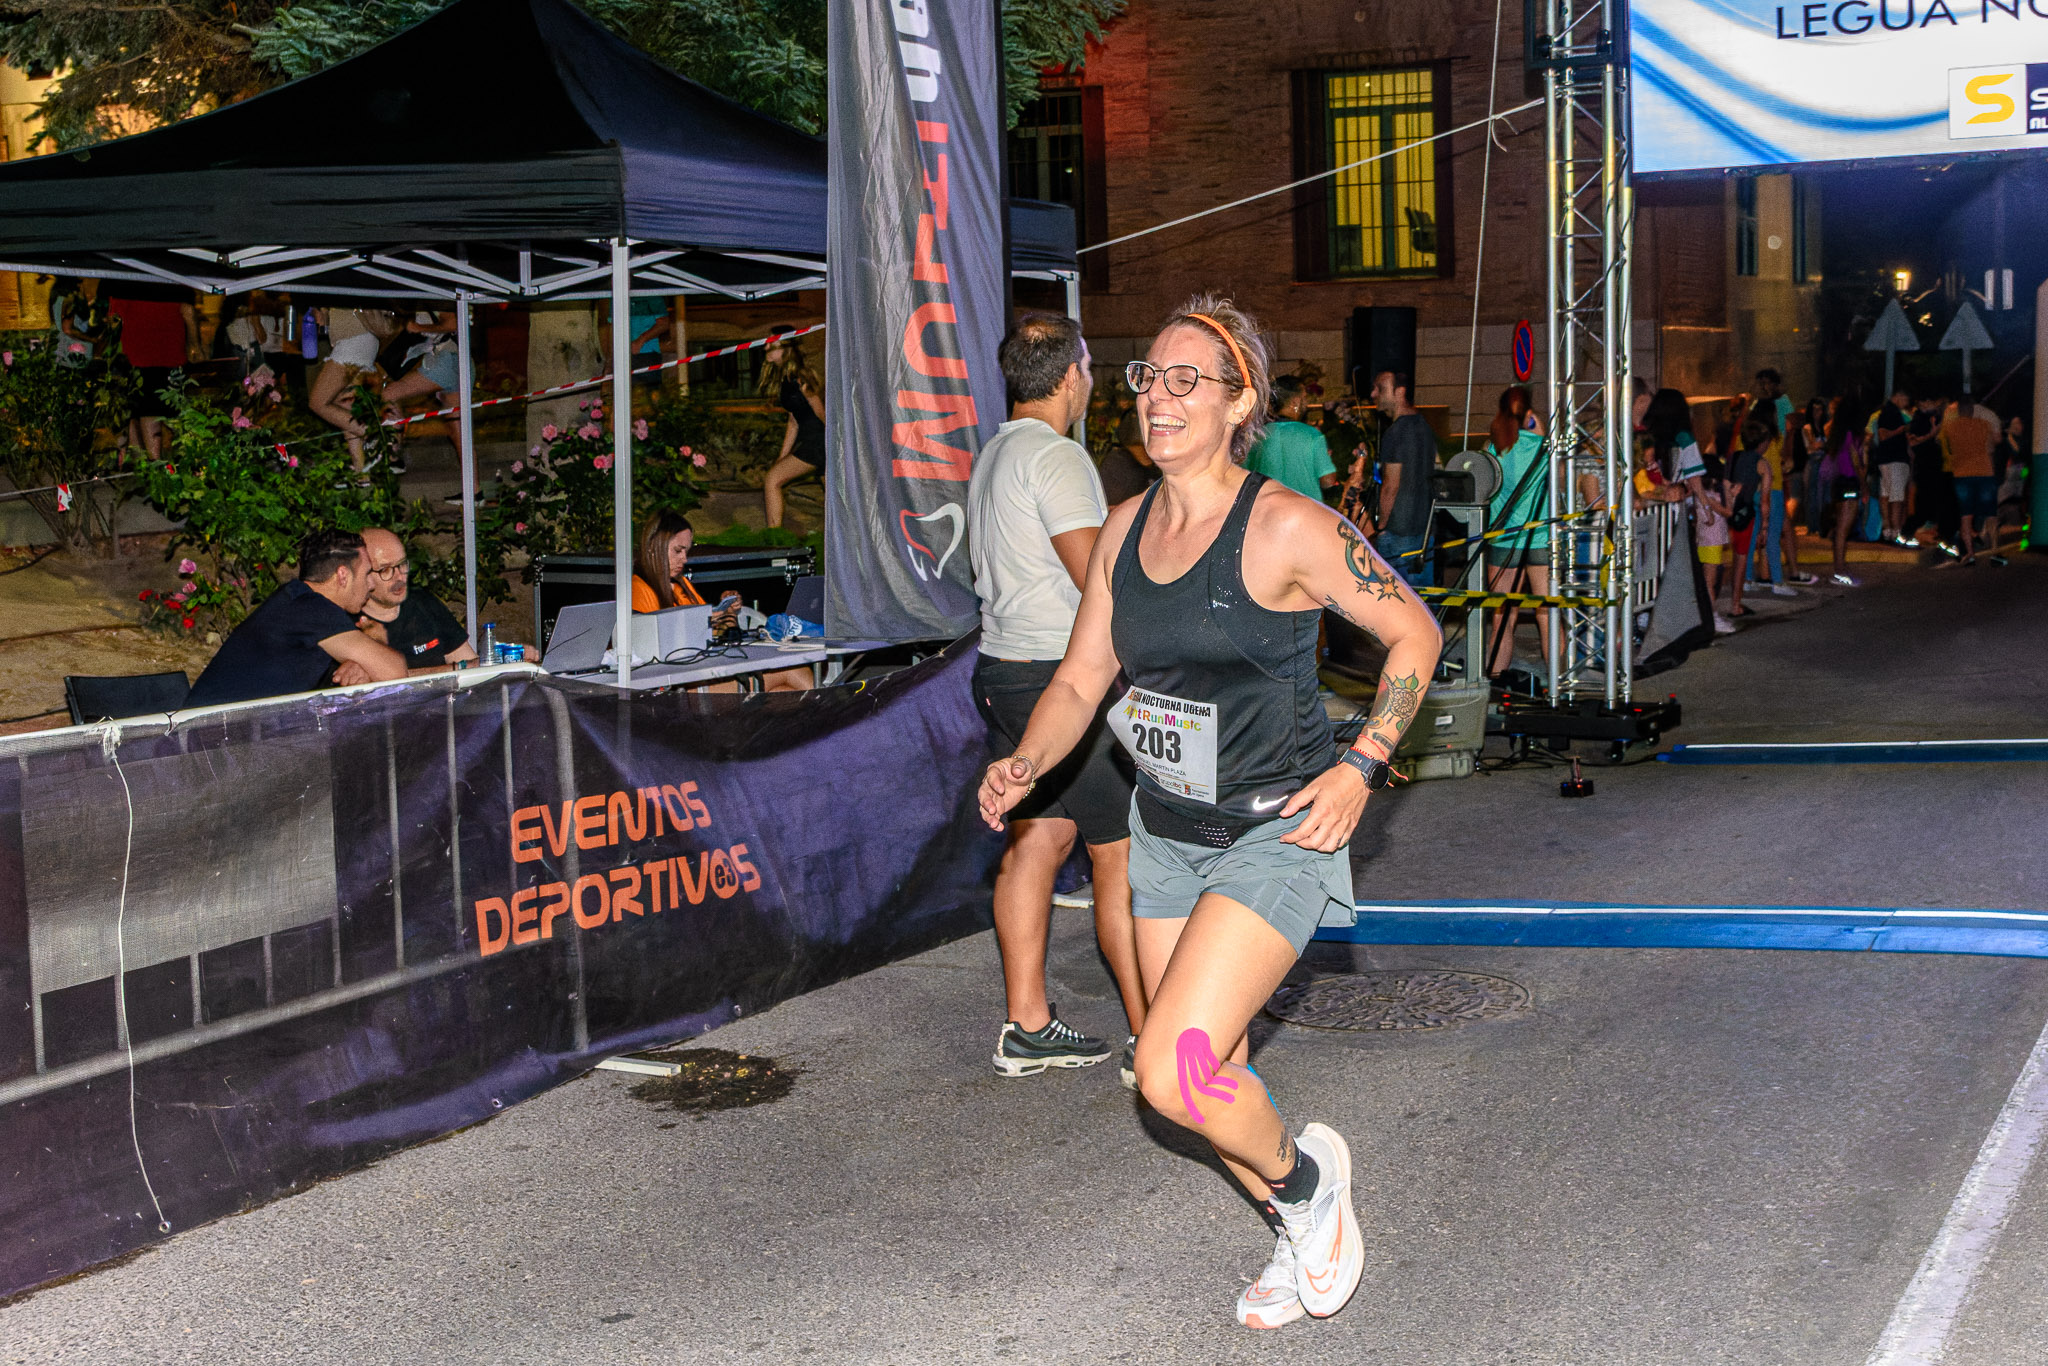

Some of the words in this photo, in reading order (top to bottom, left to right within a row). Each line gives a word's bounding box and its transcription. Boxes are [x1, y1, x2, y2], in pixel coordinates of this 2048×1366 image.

[1776, 0, 1959, 39] LEGUA
[1142, 692, 1181, 713] NOCTURNA
[1132, 723, 1182, 764] 203
[511, 781, 712, 864] EVENTOS
[475, 843, 761, 958] DEPORTIVOS
